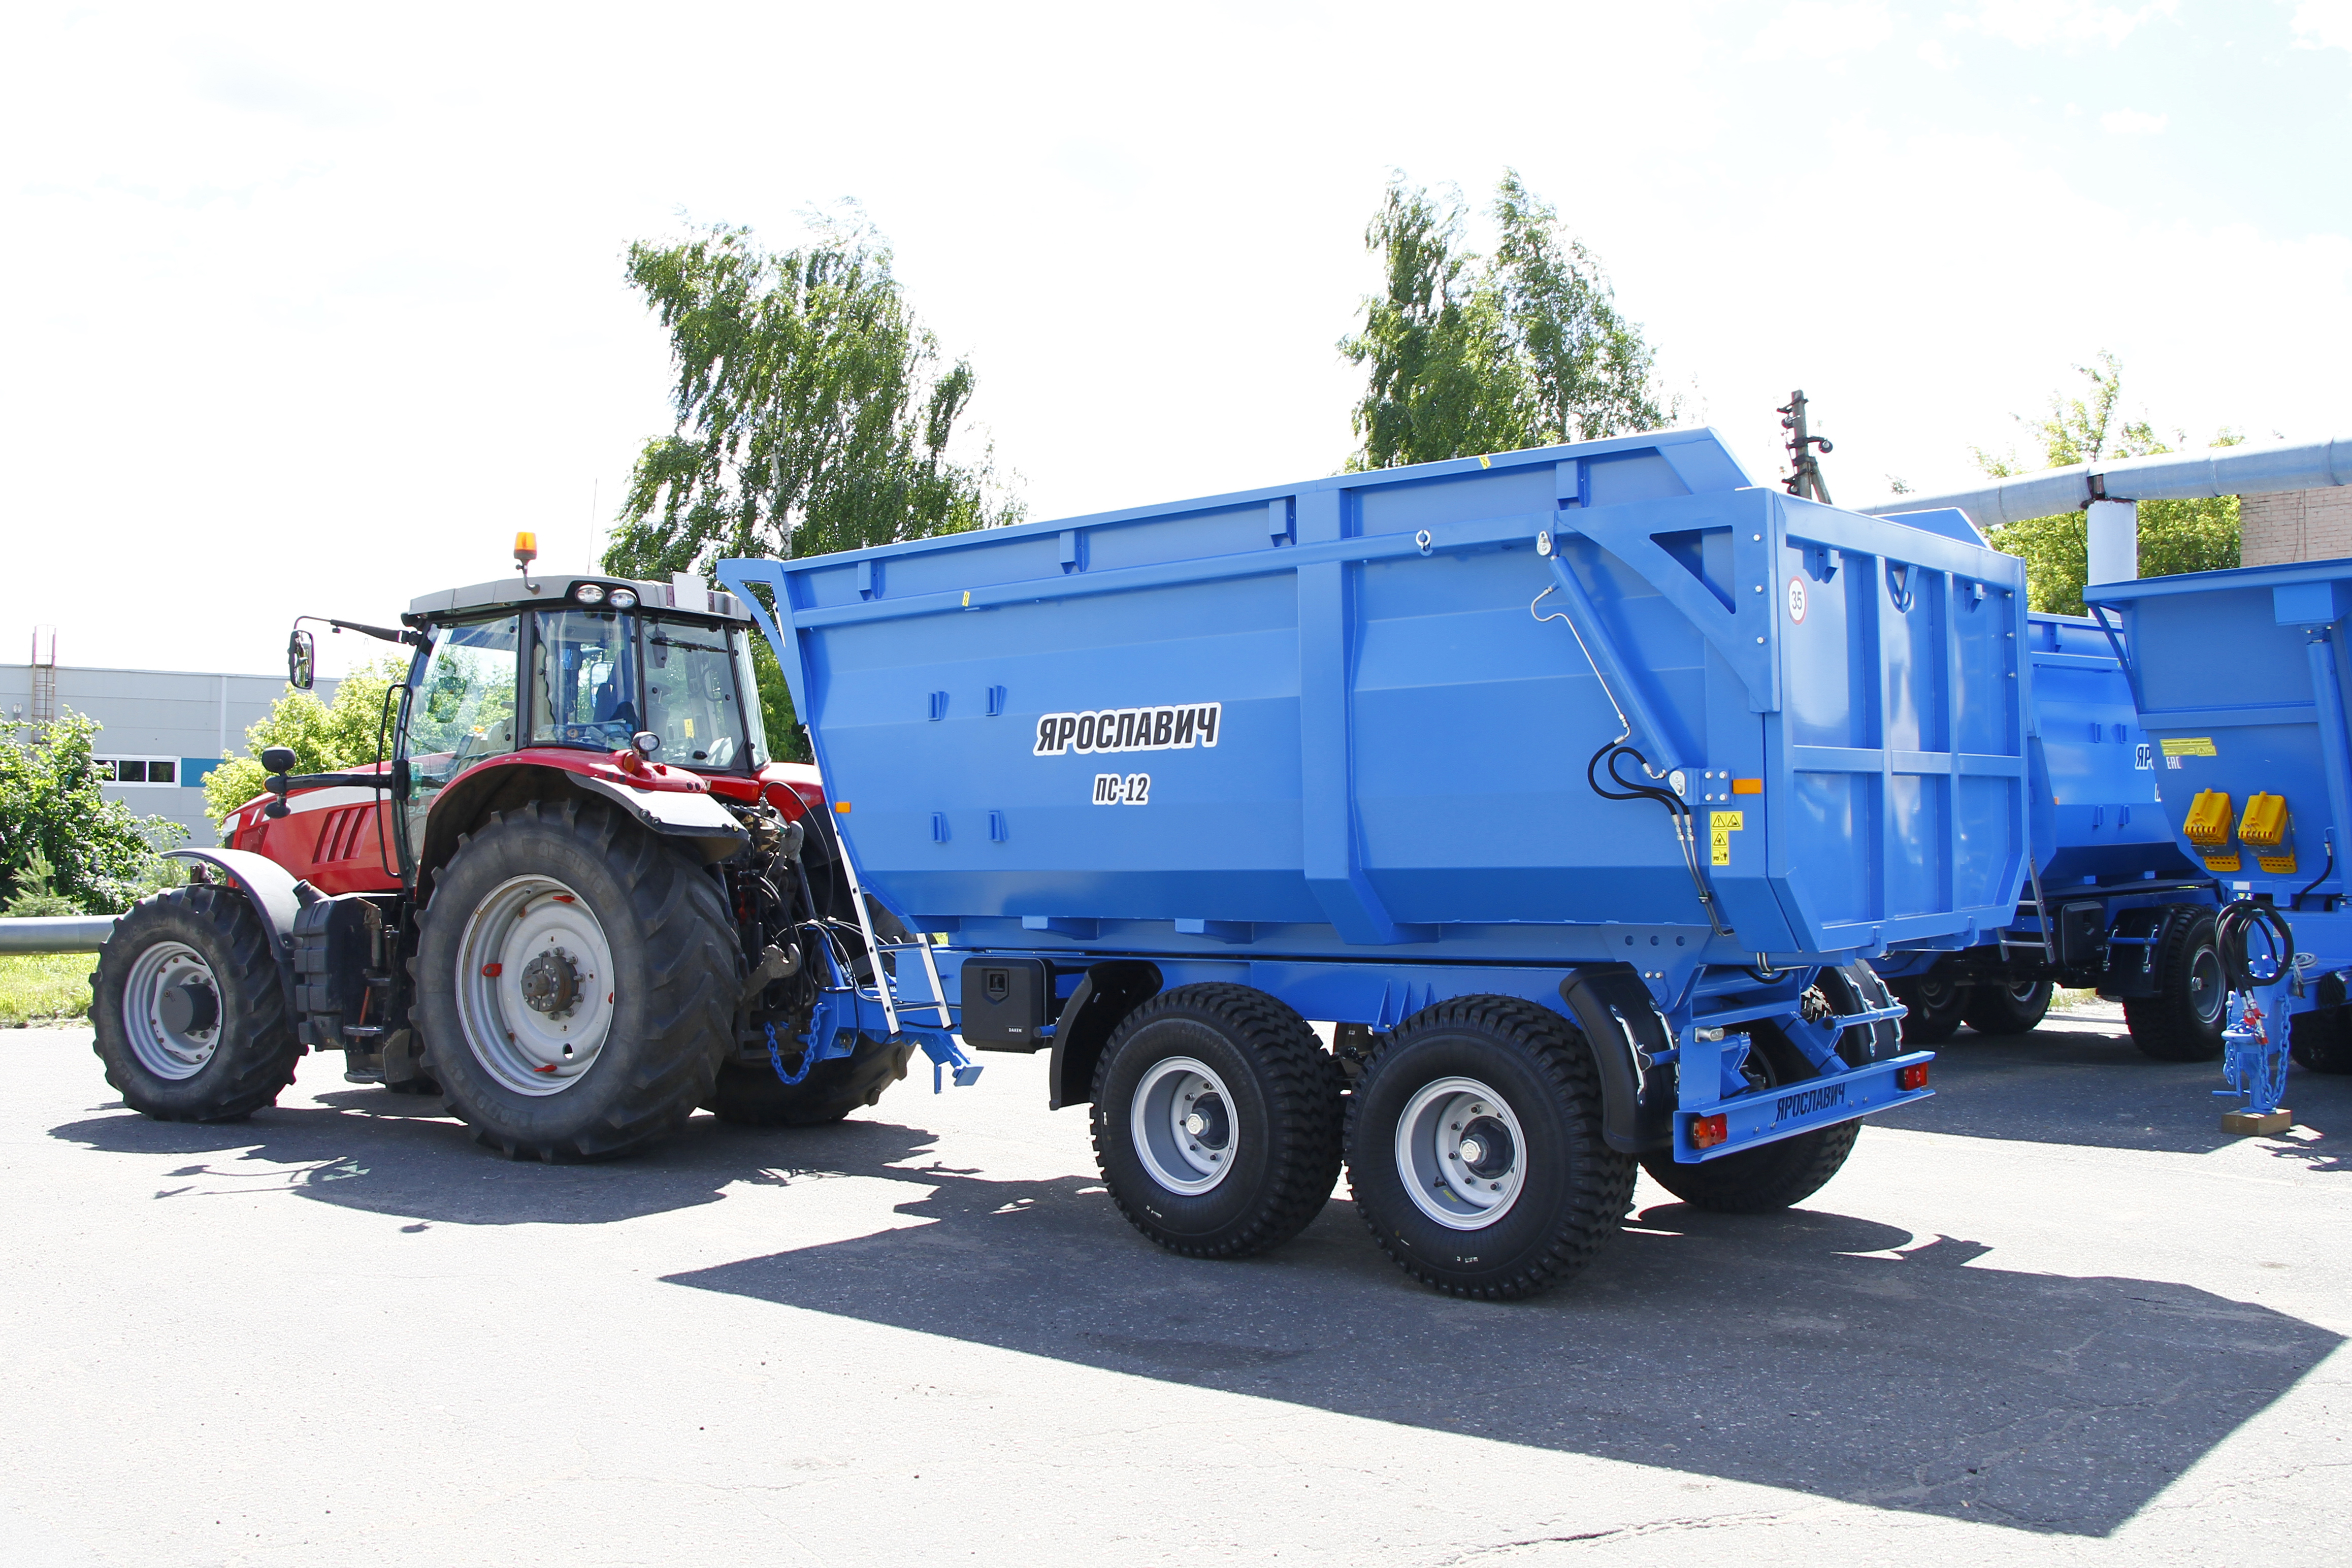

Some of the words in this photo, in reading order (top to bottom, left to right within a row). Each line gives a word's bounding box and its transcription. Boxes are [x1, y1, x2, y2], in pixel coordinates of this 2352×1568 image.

[1791, 590, 1803, 610] 35
[1037, 706, 1218, 752] ЯРОСЛАВИЧ
[2136, 746, 2151, 767] ЯР
[2166, 756, 2181, 769] EAC
[1095, 776, 1149, 802] ПС-12
[1775, 1082, 1846, 1122] ЯРОСЛАВИЧ
